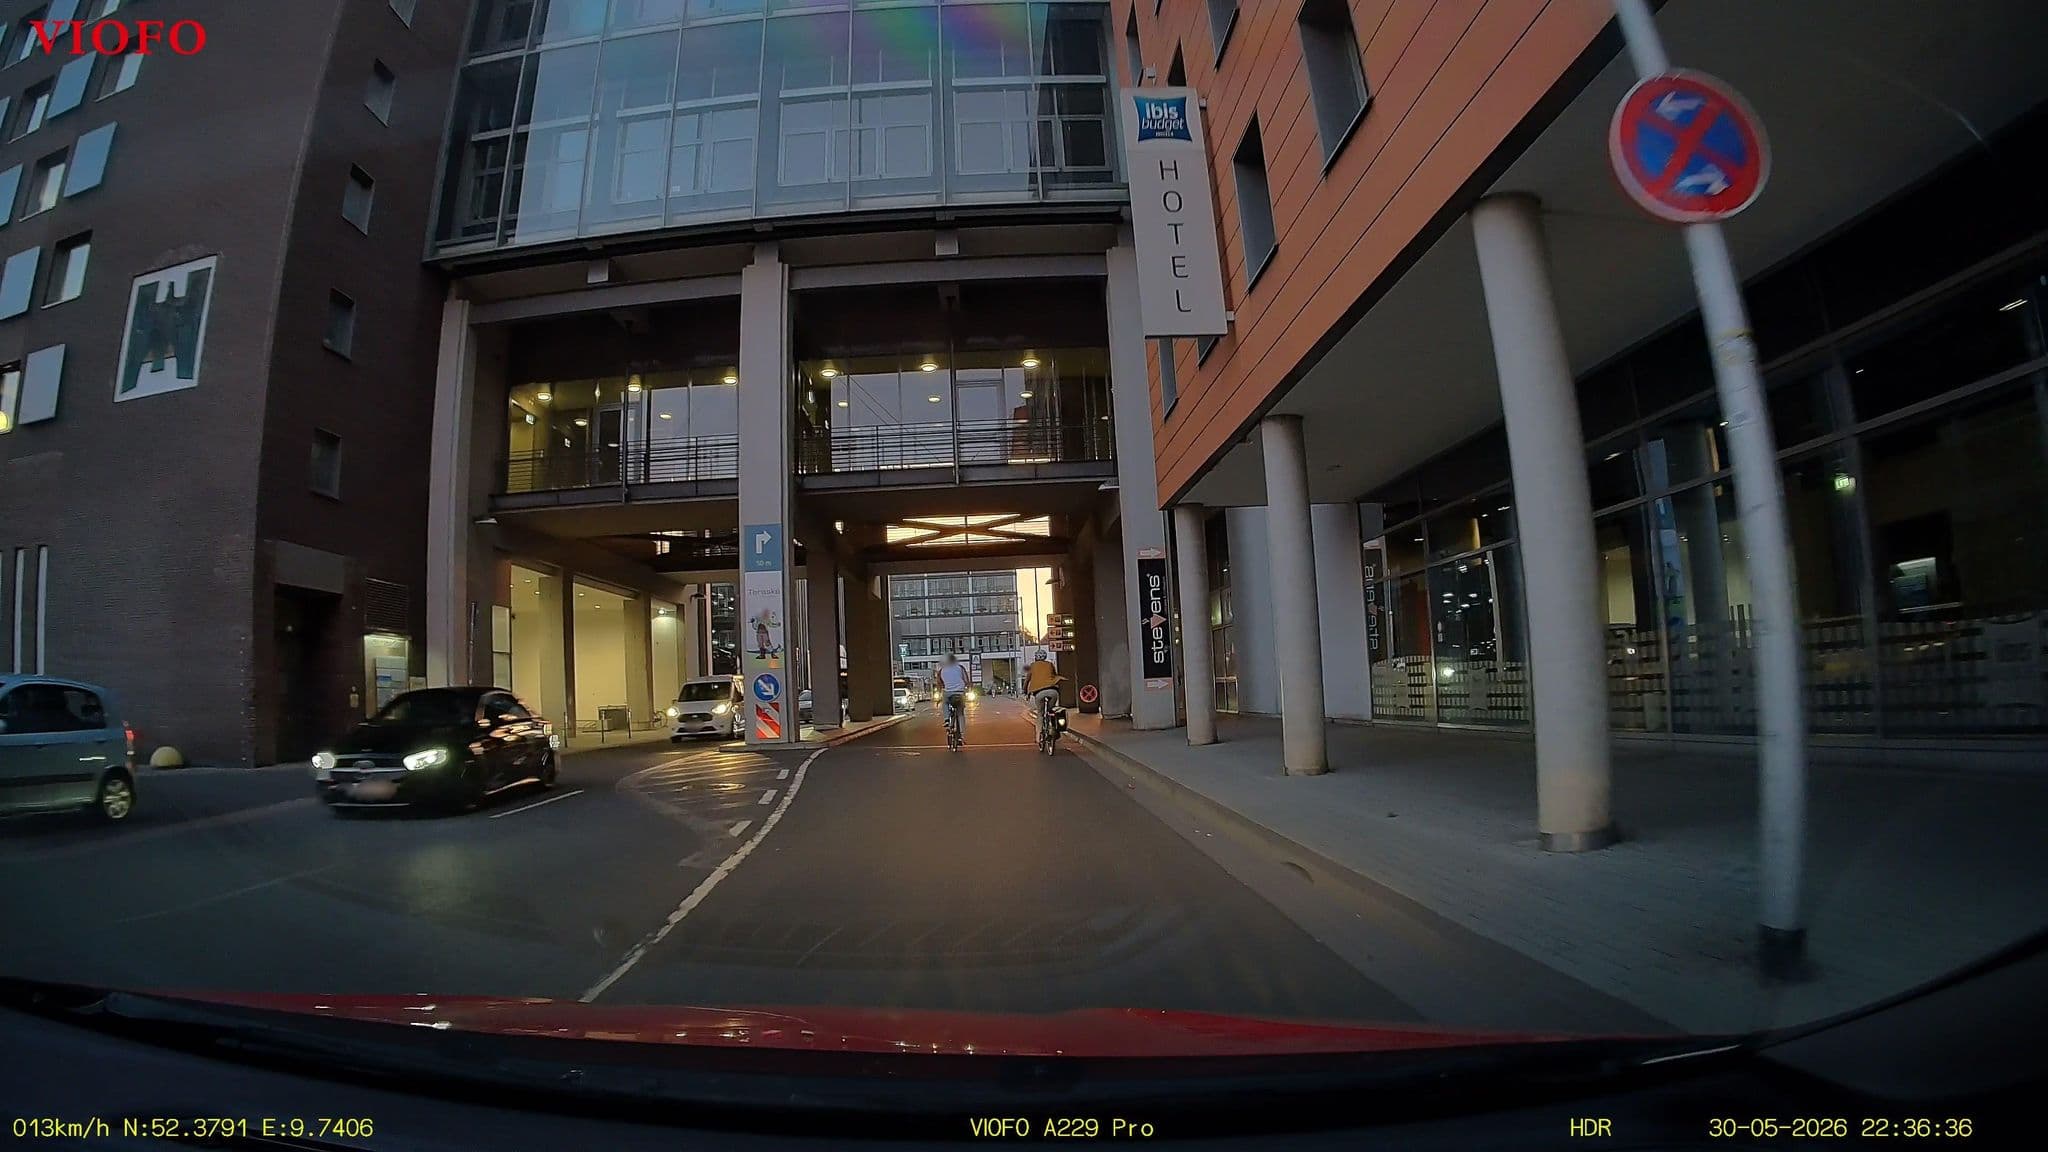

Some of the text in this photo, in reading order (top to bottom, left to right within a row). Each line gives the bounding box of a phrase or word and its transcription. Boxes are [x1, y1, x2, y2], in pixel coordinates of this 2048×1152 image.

[1141, 117, 1185, 131] budget
[1145, 102, 1179, 120] ibis
[1159, 159, 1192, 313] HOTEL
[1149, 574, 1167, 664] stevens
